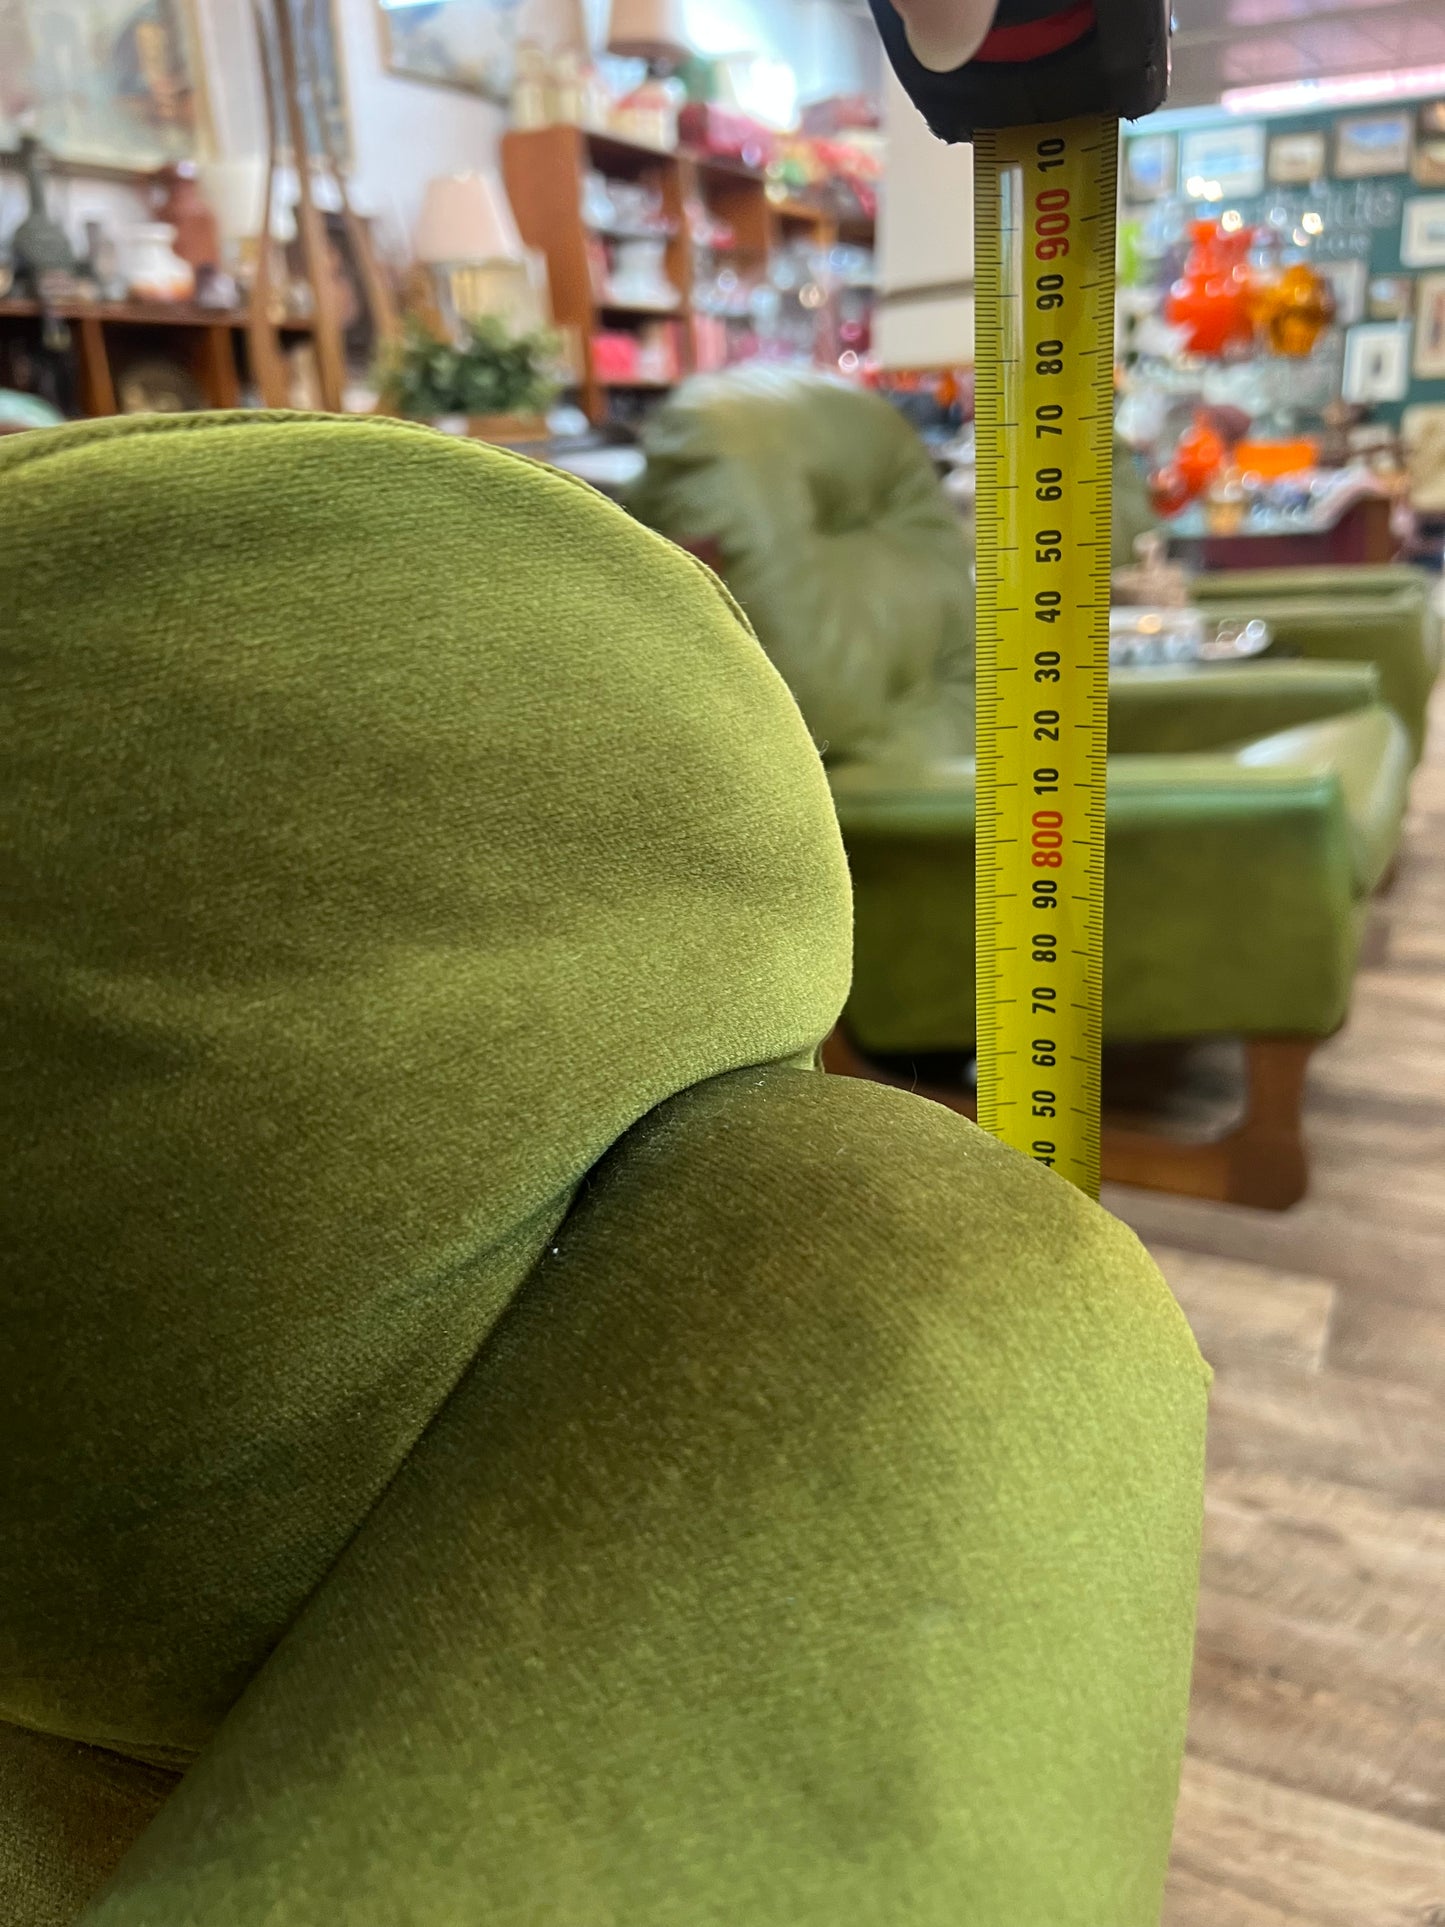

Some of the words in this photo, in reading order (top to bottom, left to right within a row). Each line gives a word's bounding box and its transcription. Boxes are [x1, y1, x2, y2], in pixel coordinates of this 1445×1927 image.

[1036, 137, 1066, 173] 10
[1035, 188, 1071, 261] 900
[1035, 273, 1065, 311] 90
[1035, 339, 1064, 376] 80
[1035, 404, 1064, 439] 70
[1035, 467, 1063, 502] 60
[1035, 529, 1062, 563] 50
[1034, 590, 1062, 624] 40
[1034, 650, 1061, 683] 30
[1033, 709, 1060, 742] 20
[1032, 767, 1060, 796] 10
[1031, 810, 1064, 869] 800
[1031, 879, 1058, 909] 90
[1031, 933, 1057, 963] 80
[1031, 986, 1057, 1014] 70
[1031, 1039, 1057, 1067] 60
[1031, 1089, 1056, 1118] 50
